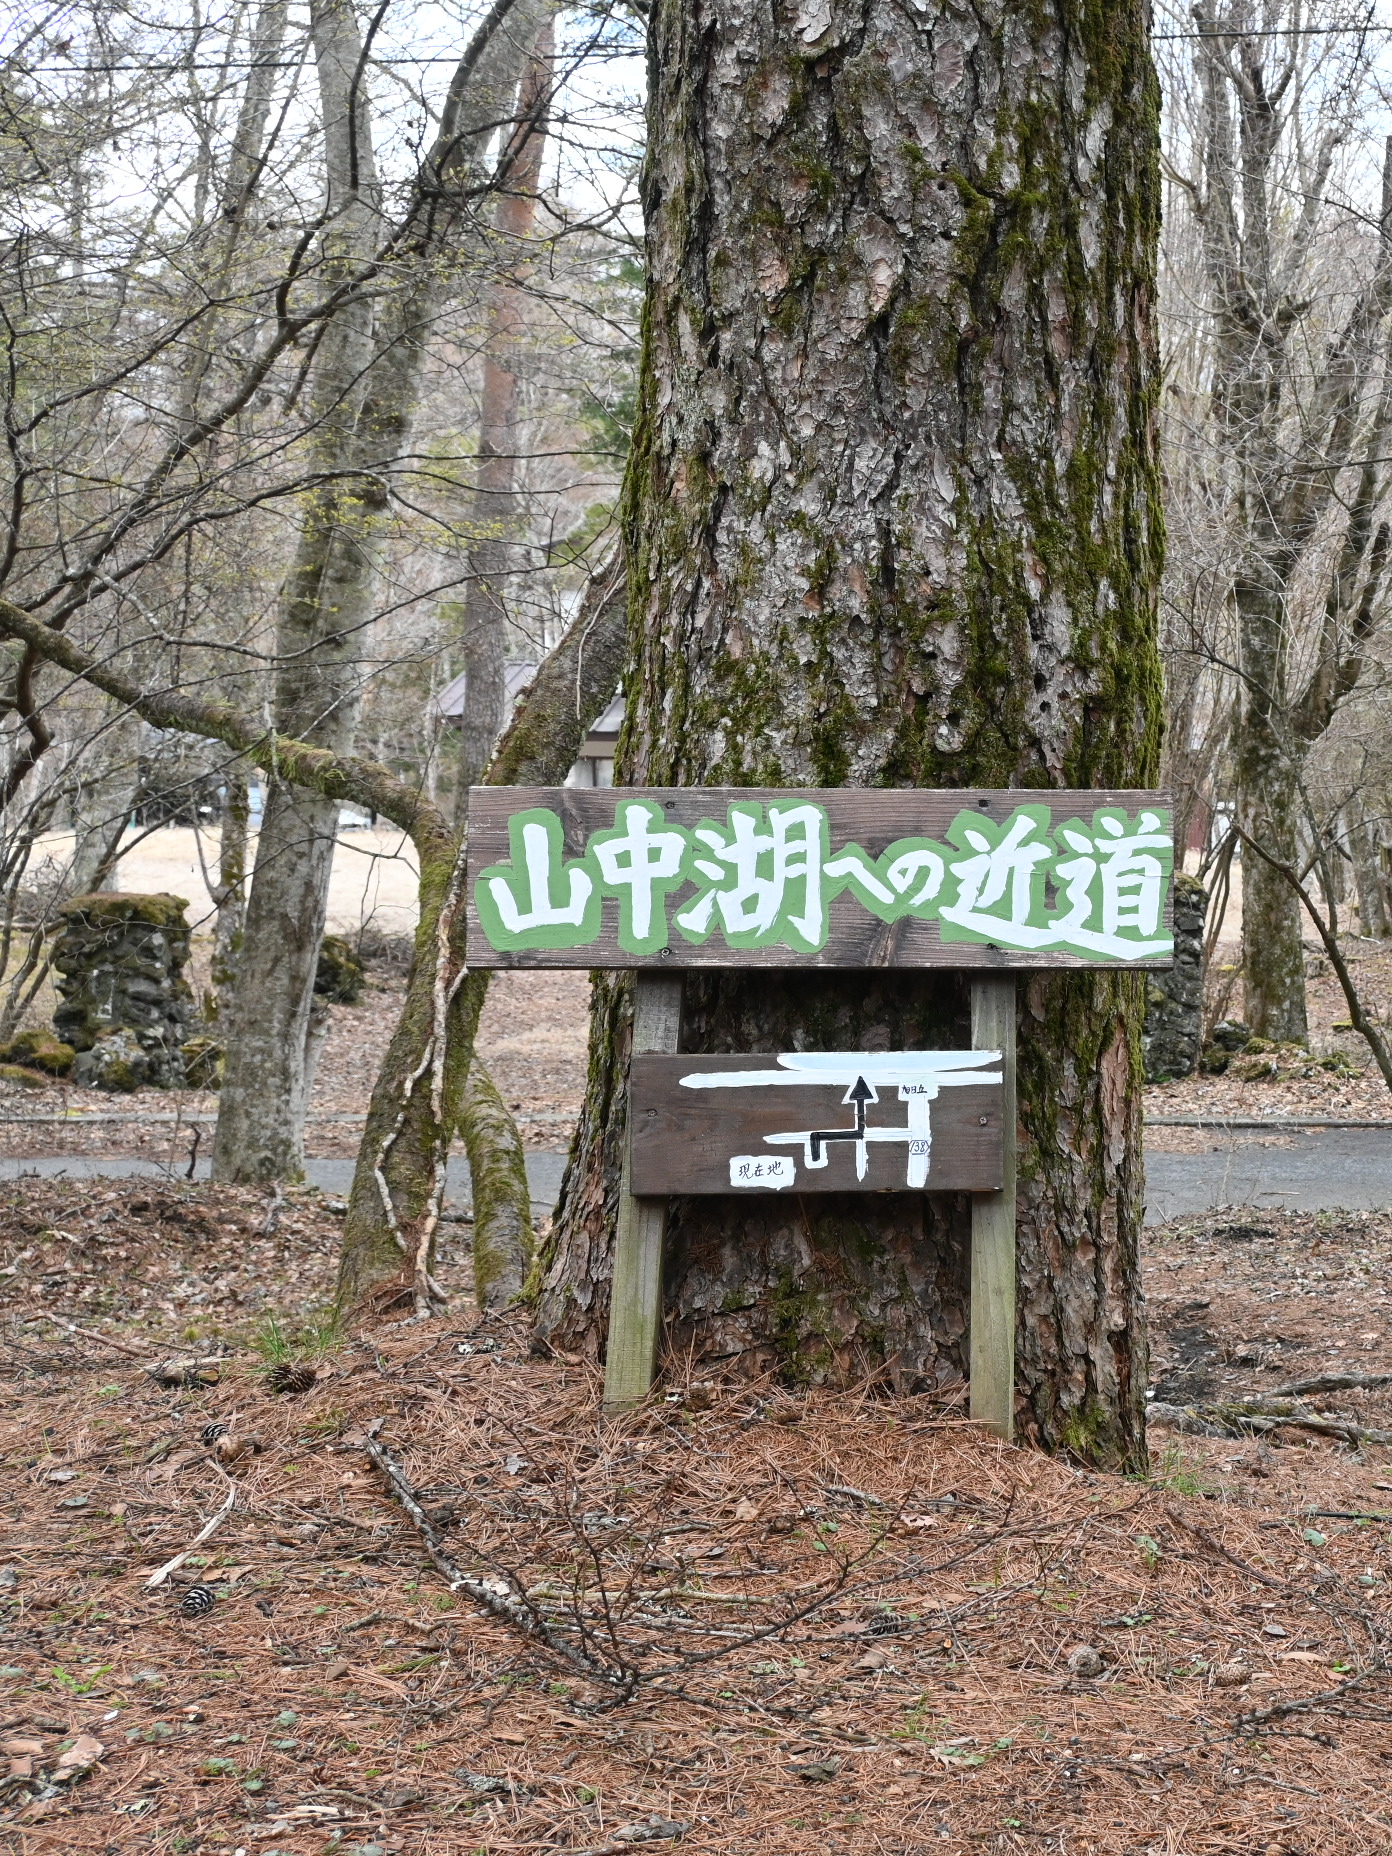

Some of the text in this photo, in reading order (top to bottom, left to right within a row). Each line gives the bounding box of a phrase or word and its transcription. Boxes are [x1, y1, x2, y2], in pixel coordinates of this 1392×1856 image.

[487, 803, 1174, 961] 山中湖への近道
[738, 1160, 784, 1180] 現在地
